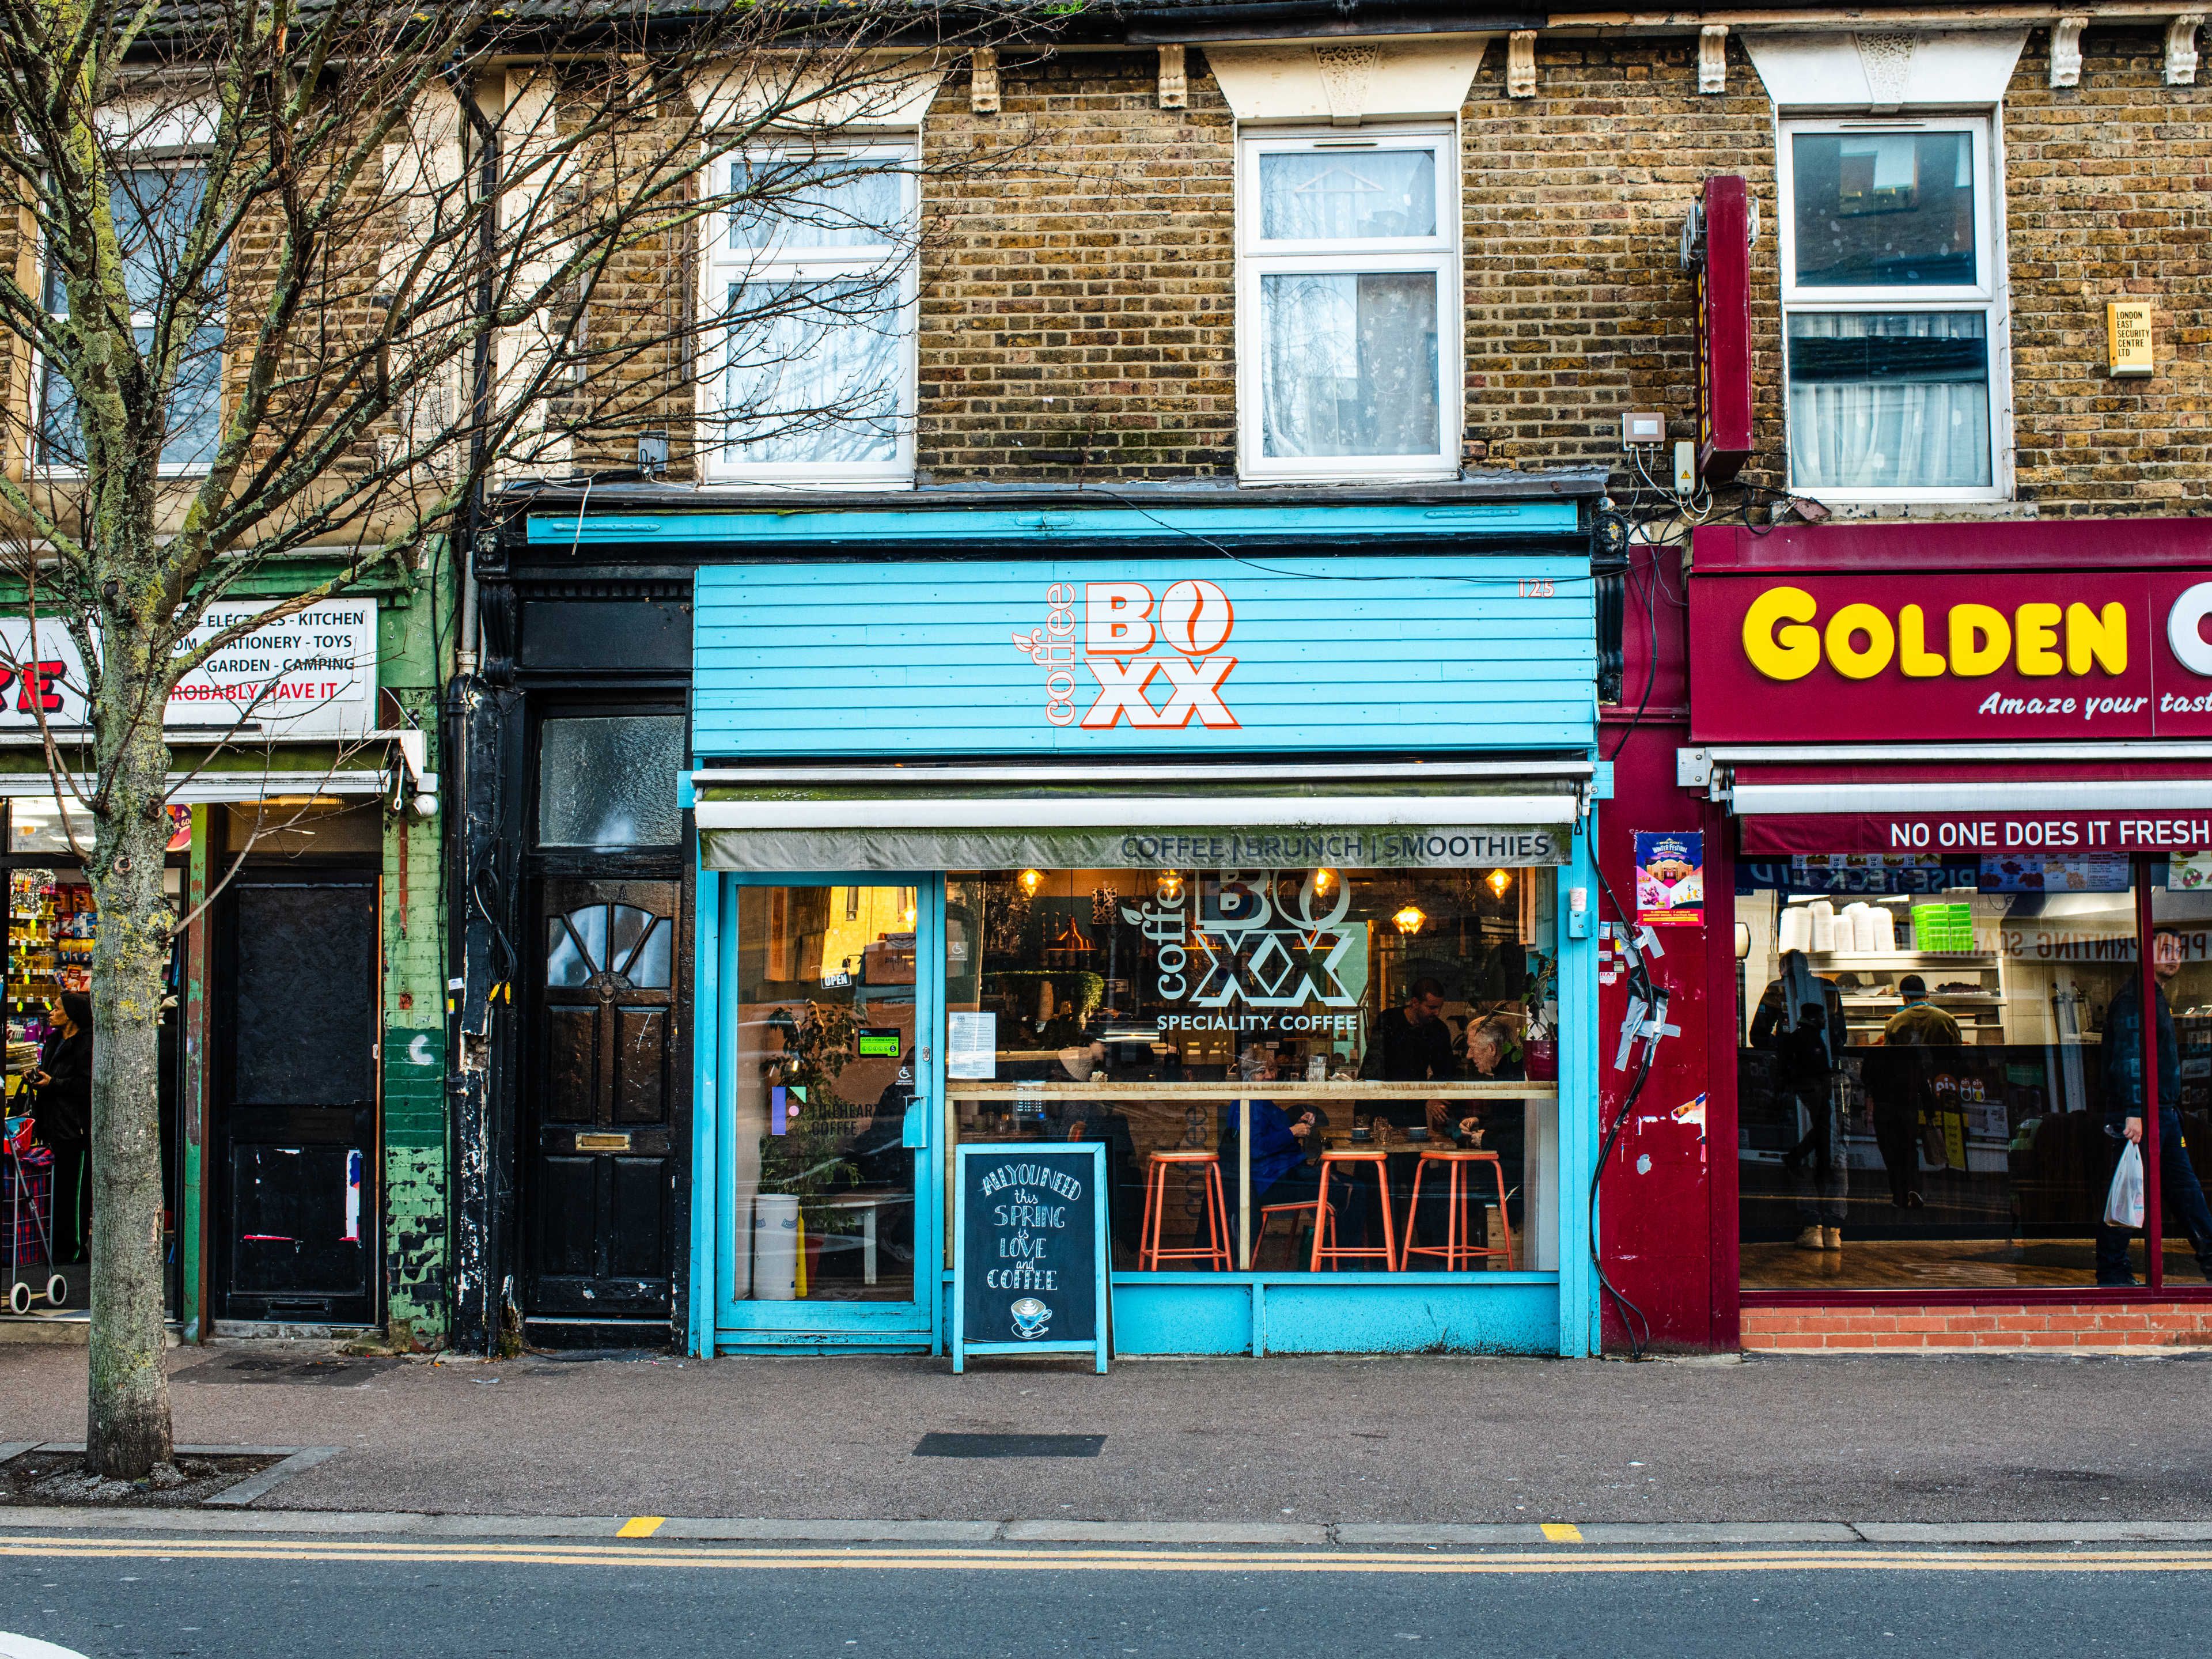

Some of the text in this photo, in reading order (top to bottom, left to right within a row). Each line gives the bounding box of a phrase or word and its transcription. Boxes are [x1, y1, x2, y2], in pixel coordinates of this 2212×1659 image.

[2116, 311, 2143, 320] LONDON
[2117, 320, 2133, 328] EAST
[2118, 329, 2150, 338] SECURITY
[2118, 339, 2144, 347] CENTRE
[2118, 349, 2130, 357] LTD
[1518, 578, 1555, 598] 125
[298, 612, 364, 626] KITCHEN
[313, 635, 352, 648] TOYS
[1743, 586, 2128, 681] GOLDEN
[1031, 582, 1076, 727] coffee
[206, 657, 355, 673] GARDEN CAMPING
[171, 683, 259, 701] ROBABLY
[321, 683, 338, 699] IT
[1978, 692, 2077, 715] Amaze
[2084, 695, 2148, 719] your
[1891, 820, 2210, 847] NO ONE DOES IT FRESH
[1121, 835, 1550, 858] COFFEE BRUNCH SMOOTHIES
[824, 974, 848, 986] OPEN
[1157, 1014, 1358, 1031] SPECIALITY COFFEE
[982, 1164, 1081, 1201] ALL YOU NEED
[1014, 1188, 1039, 1204] this
[994, 1205, 1065, 1228] SPRING
[1018, 1228, 1029, 1239] is
[999, 1237, 1047, 1258] LOVE
[1016, 1257, 1034, 1271] and
[987, 1269, 1058, 1291] COFFEE
